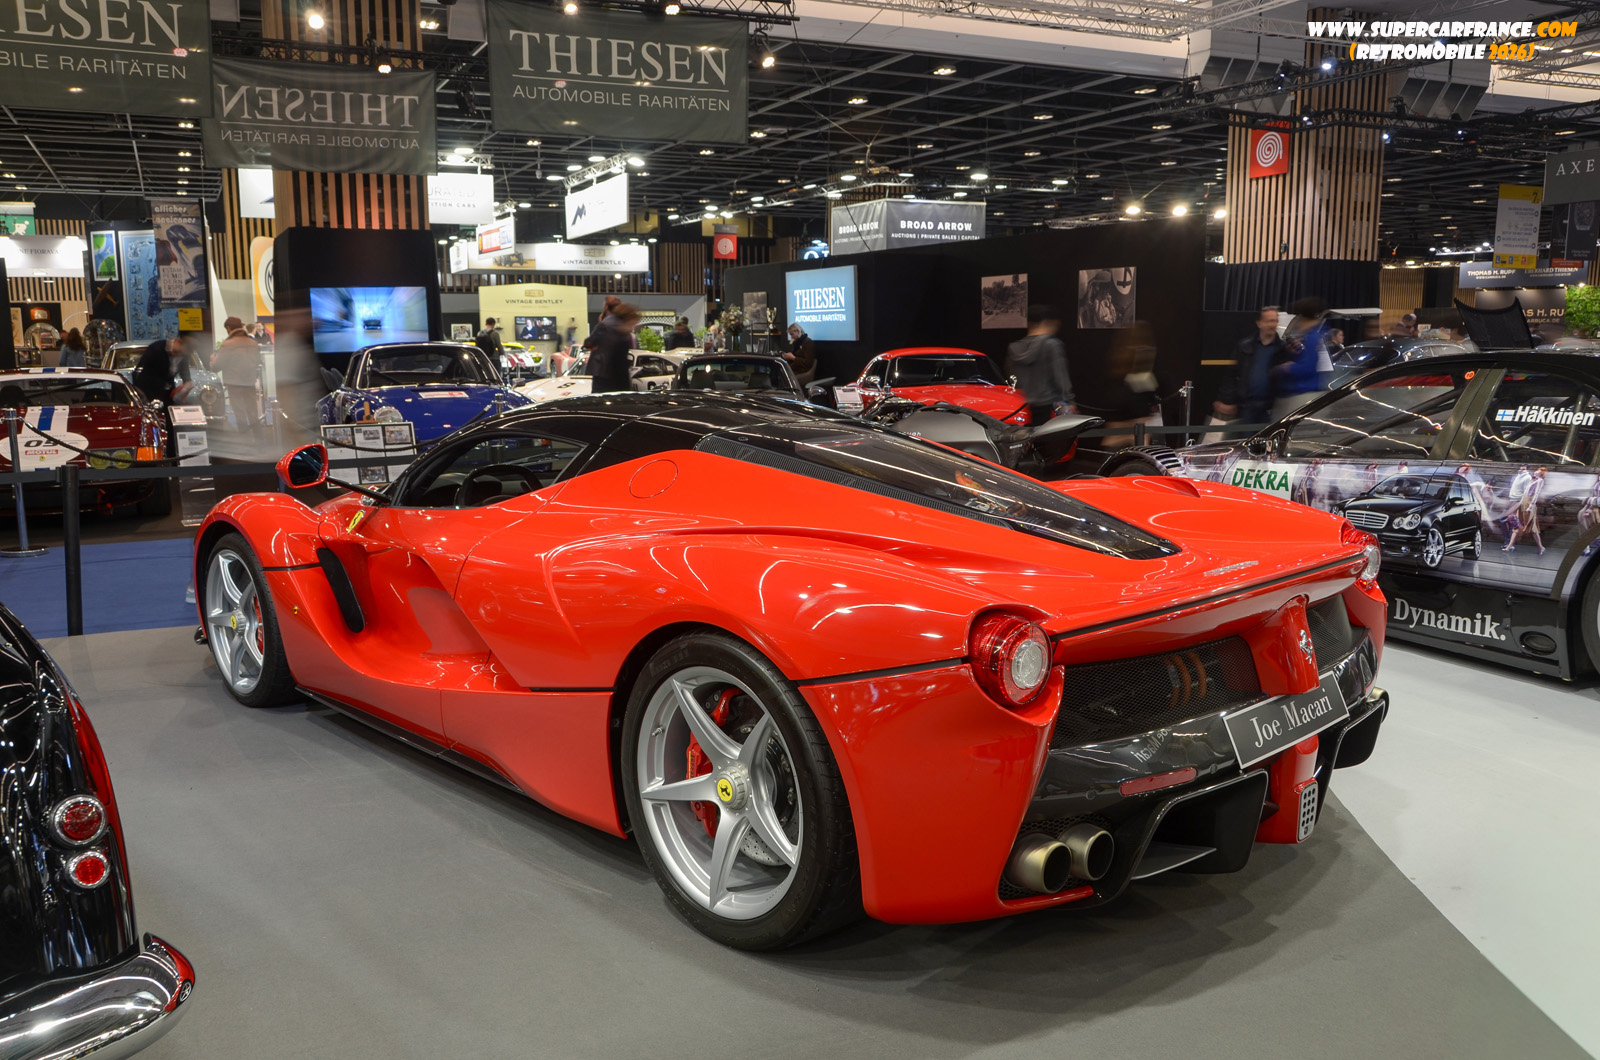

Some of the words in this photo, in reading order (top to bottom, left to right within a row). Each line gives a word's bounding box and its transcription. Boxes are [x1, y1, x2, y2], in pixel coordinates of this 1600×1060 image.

[0, 0, 183, 48] ESEN
[59, 55, 187, 80] RARITÄTEN
[509, 29, 730, 86] THIESEN
[512, 84, 632, 106] AUTOMOBILE
[638, 93, 731, 112] RARITÄTEN
[900, 220, 935, 230] BROAD
[937, 222, 973, 231] ARROW
[793, 286, 846, 309] THIESEN
[795, 314, 822, 322] AUTOMOBILE
[822, 312, 847, 321] RARITÄTEN
[1514, 405, 1596, 426] Häkkinen
[1231, 468, 1289, 491] DEKRA
[1393, 598, 1507, 641] Dynamik.
[1249, 716, 1283, 748] Joe
[1280, 687, 1333, 731] Macari
